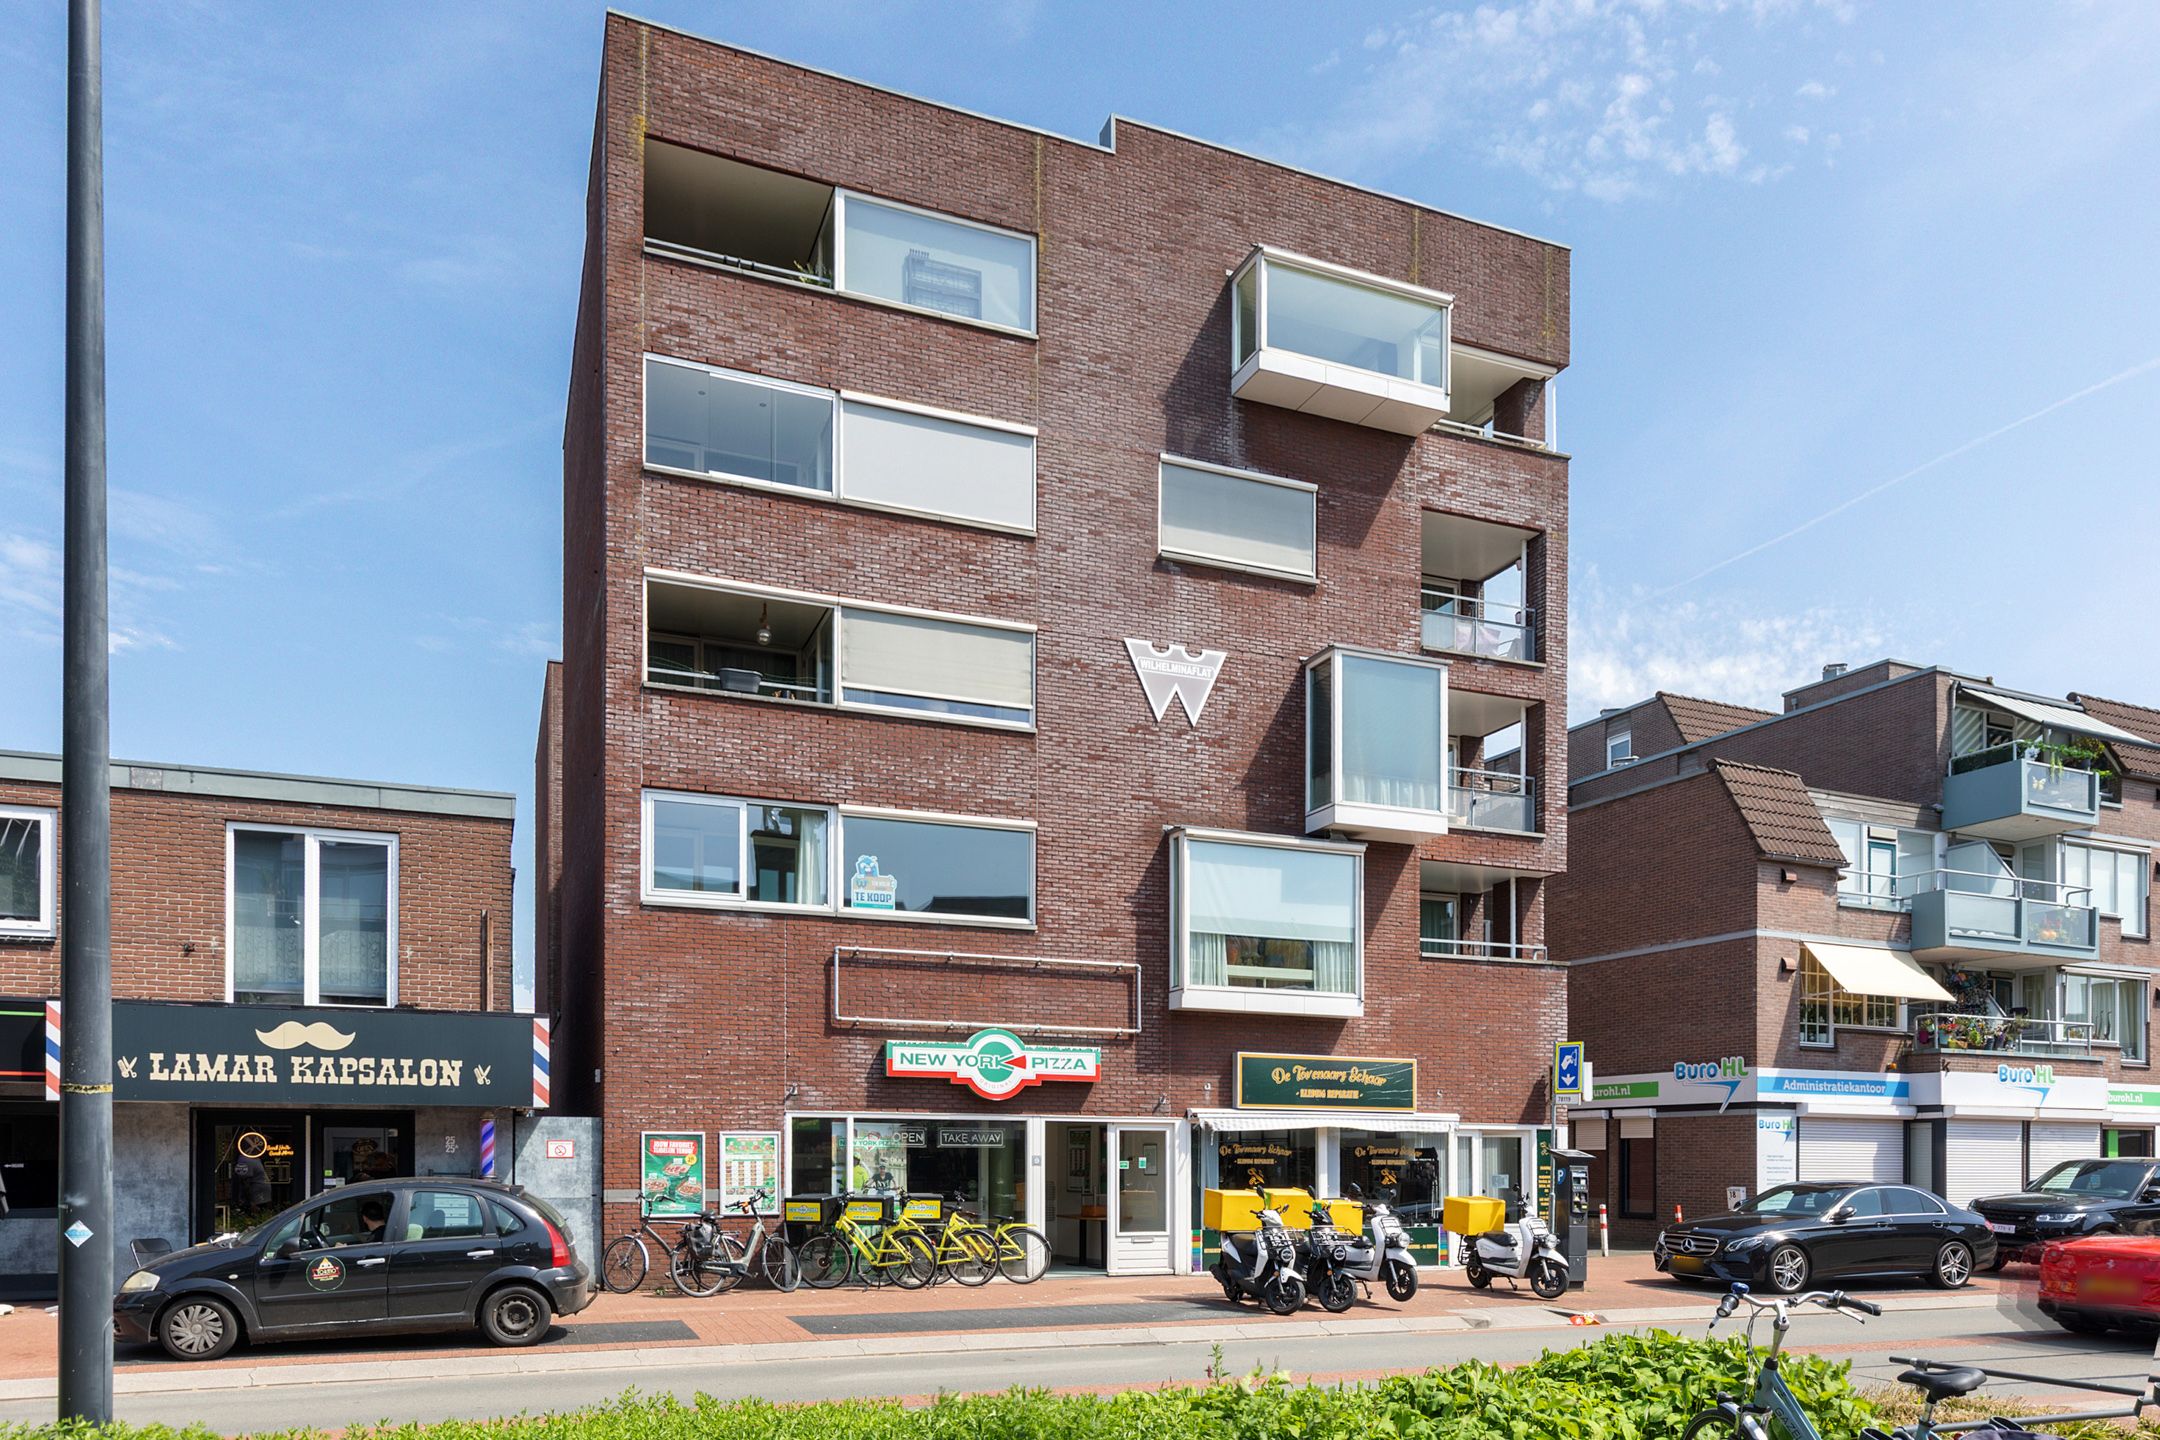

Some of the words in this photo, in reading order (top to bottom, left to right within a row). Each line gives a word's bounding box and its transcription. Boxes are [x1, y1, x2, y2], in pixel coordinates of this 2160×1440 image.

[1140, 659, 1212, 678] WILHELMINAFLAT
[855, 892, 866, 901] TE
[867, 893, 892, 903] KOOP
[900, 1052, 947, 1066] NEW
[952, 1053, 1014, 1070] YORK
[1031, 1057, 1087, 1070] PIZZA
[1675, 1062, 1719, 1080] Buro
[1721, 1057, 1749, 1077] HL
[149, 1052, 277, 1083] LAMAR
[290, 1055, 463, 1087] KAPSALON
[1271, 1067, 1291, 1084] De
[1348, 1066, 1387, 1086] Schaar
[1999, 1065, 2033, 1083] Buro
[2036, 1065, 2056, 1084] HL
[1593, 1085, 1631, 1098] urohl.nl
[1783, 1079, 1886, 1094] Administratiekantoor
[2108, 1092, 2143, 1104] burohl.nl
[1758, 1119, 1780, 1129] Buro
[1782, 1119, 1795, 1130] HL
[445, 1136, 456, 1144] 25
[893, 1132, 924, 1143] OPEN
[942, 1132, 968, 1143] TAKE
[971, 1132, 1001, 1143] AWAY
